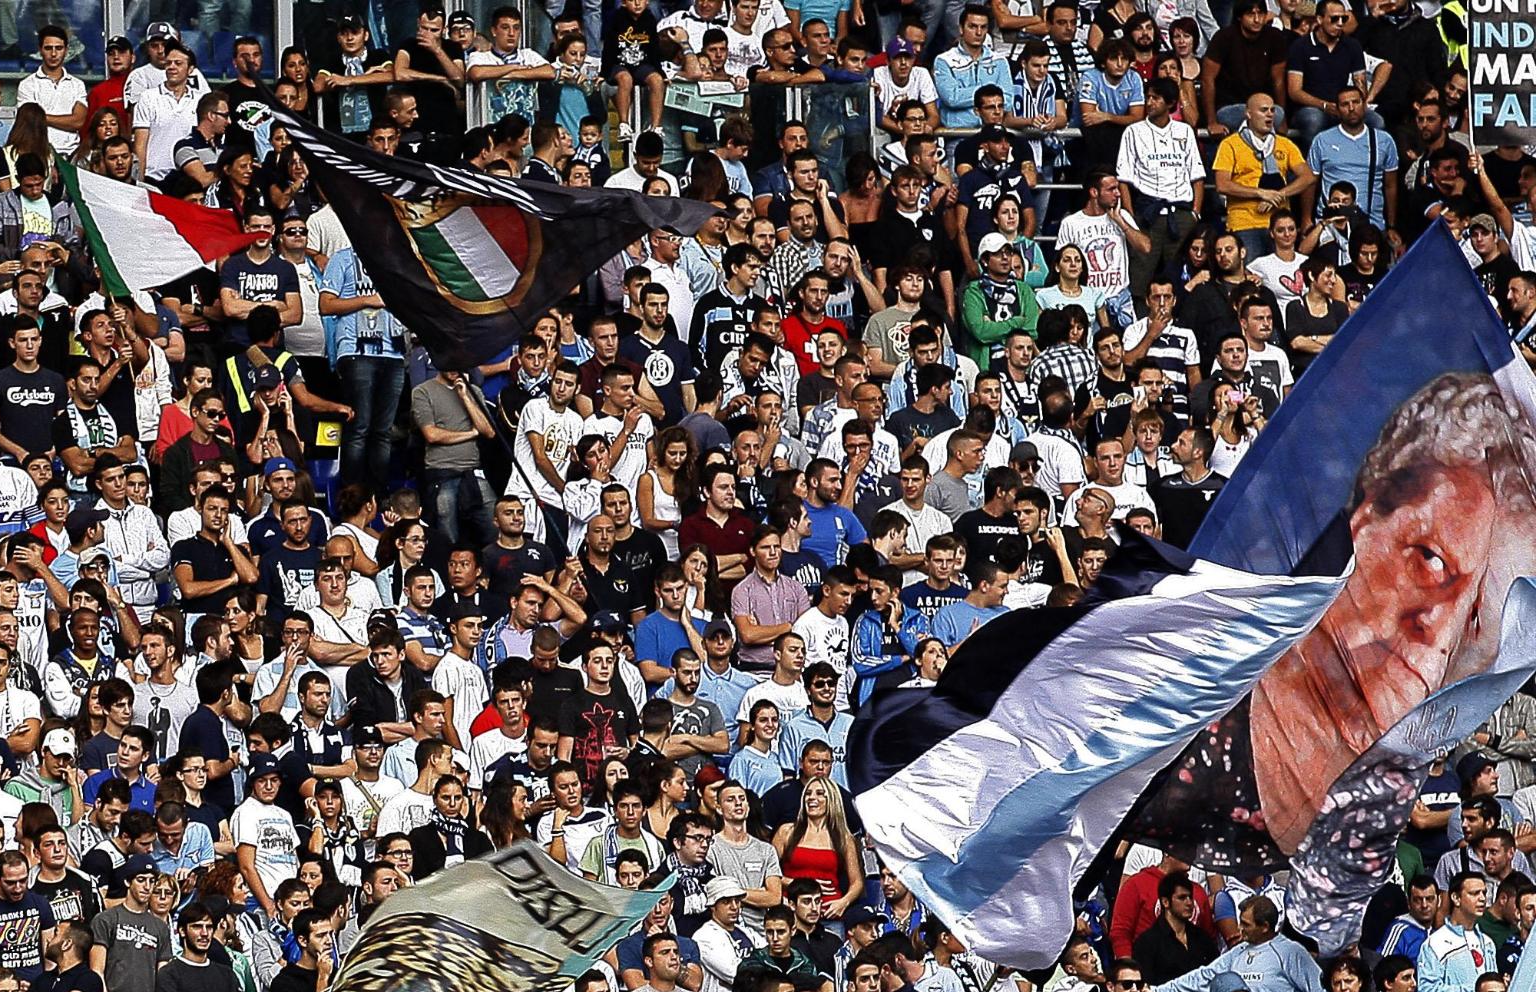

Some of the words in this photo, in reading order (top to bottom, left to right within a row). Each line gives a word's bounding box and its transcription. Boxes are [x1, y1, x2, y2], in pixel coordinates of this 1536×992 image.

[1474, 94, 1536, 127] FA
[719, 332, 749, 344] CIR
[7, 386, 55, 406] Carlsberg
